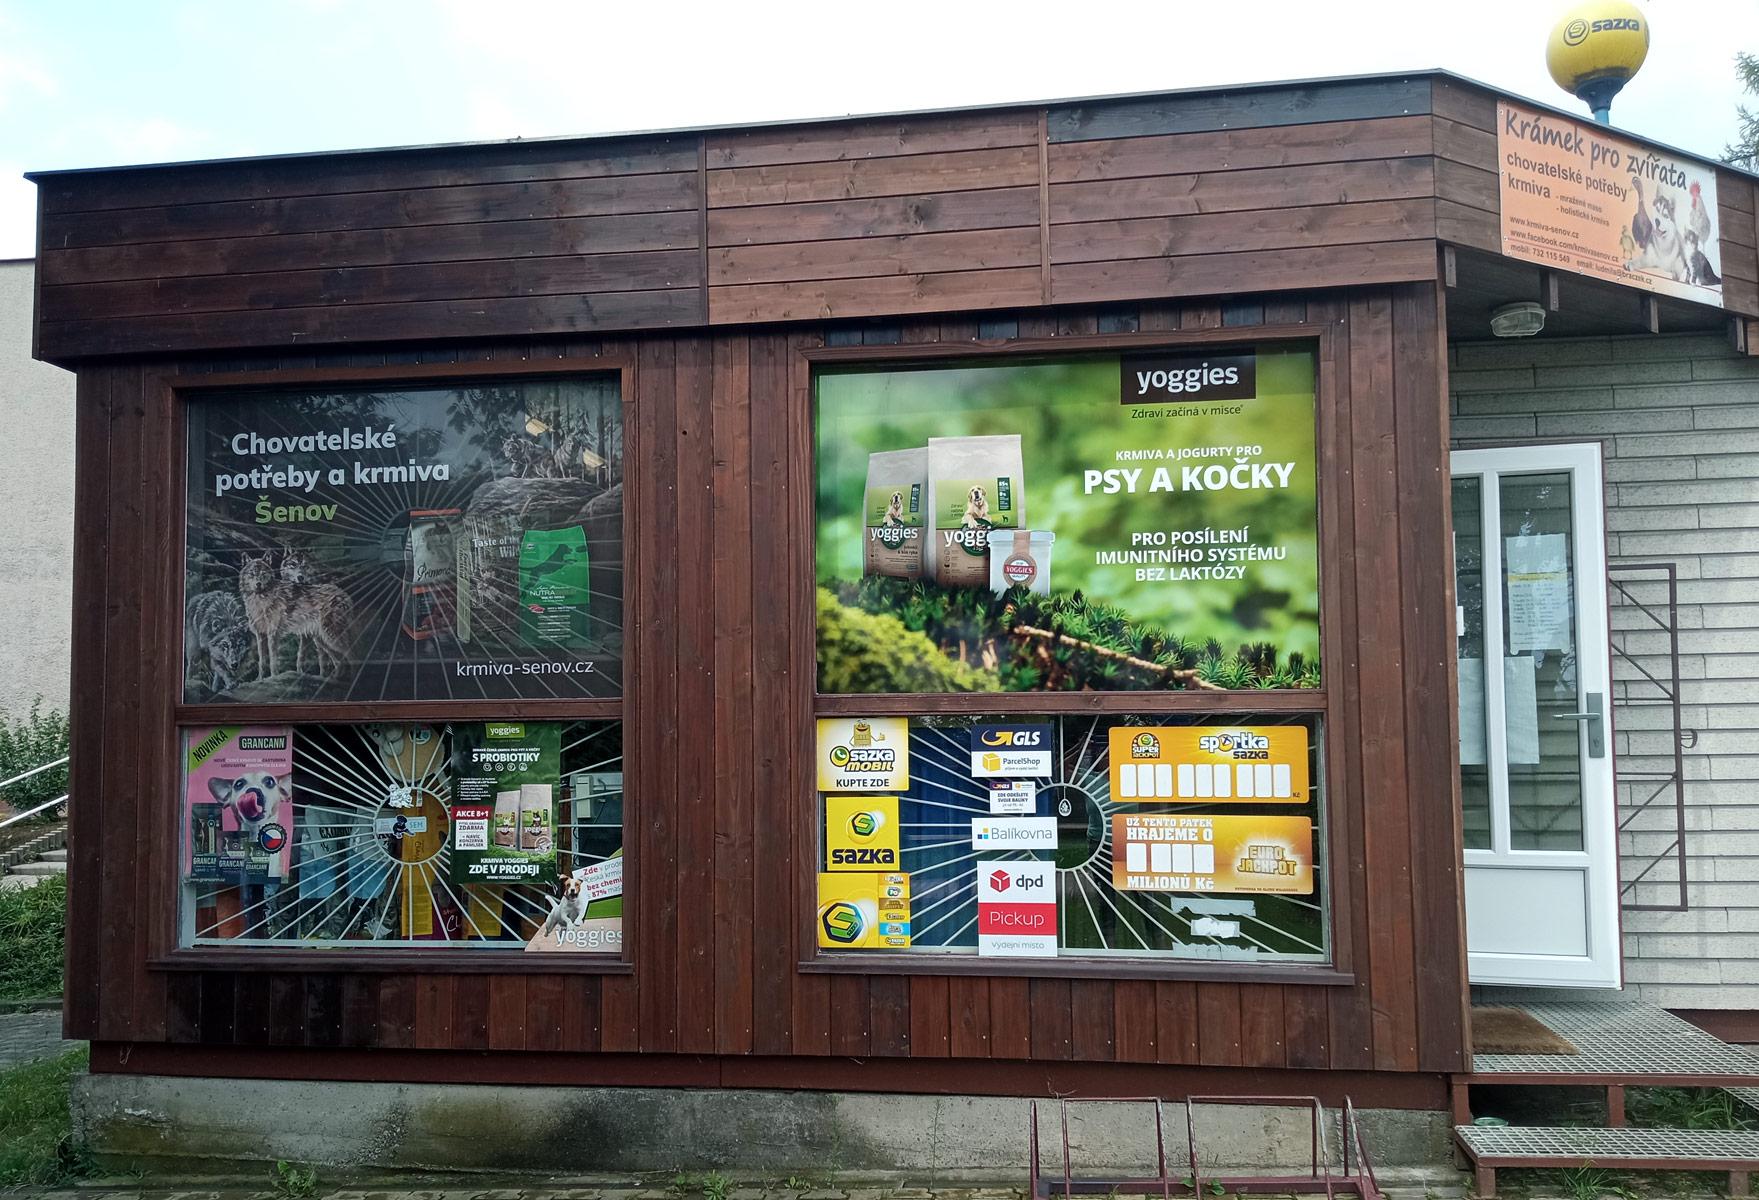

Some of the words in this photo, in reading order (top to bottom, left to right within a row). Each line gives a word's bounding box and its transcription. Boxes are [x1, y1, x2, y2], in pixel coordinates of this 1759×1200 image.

[1505, 109, 1585, 156] Krámek
[1590, 140, 1620, 170] pro
[1626, 152, 1687, 190] zvířata
[1506, 152, 1582, 184] chovatelské
[1585, 175, 1629, 202] potřeby
[1508, 172, 1551, 199] krmiva
[1509, 215, 1580, 239] www.krmiva-senov.cz
[1532, 247, 1544, 258] 732
[1546, 251, 1558, 261] 115
[1137, 362, 1238, 395] yoggies
[1131, 407, 1163, 419] Zdraví
[1166, 406, 1199, 418] začíná
[1202, 408, 1208, 417] v
[232, 424, 397, 456] Chovatelské
[1115, 449, 1164, 461] KRMIVA
[1166, 448, 1175, 459] A
[1177, 446, 1233, 461] JOGURTY
[1236, 445, 1262, 456] PRO
[216, 464, 321, 497] potřeby
[328, 468, 345, 486] a
[354, 458, 450, 485] krmiva
[1084, 468, 1143, 495] PSY
[1149, 467, 1174, 493] A
[1182, 457, 1296, 492] KOČKY
[255, 495, 338, 524] Šenov
[871, 524, 918, 542] yoggies
[944, 525, 991, 547] yogg
[1131, 532, 1166, 546] PRO
[1171, 526, 1249, 545] POSÍLENÍ
[472, 538, 497, 548] Taste
[1096, 546, 1203, 565] IMUNITNÍHO
[1208, 544, 1286, 562] SYSTÉMU
[1135, 567, 1165, 581] BEZ
[1170, 563, 1246, 581] LAKTÓZY
[456, 660, 594, 677] krmiva-senov.cz
[490, 726, 520, 736] yoggies
[1012, 731, 1041, 746] GLS
[193, 728, 229, 762] NOVINKA
[241, 737, 285, 749] GRANCANN
[1199, 732, 1270, 753] sportka
[472, 753, 479, 763] S
[480, 752, 540, 762] PROBIOTIKY
[1003, 757, 1041, 767] ParcelShop
[836, 778, 868, 788] KUPTE
[870, 778, 890, 788] ZDE
[1126, 816, 1140, 827] UŽ
[1143, 817, 1177, 827] TENTO
[991, 827, 1053, 840] Balíkovna
[1126, 827, 1199, 841] HRAJEME
[1202, 828, 1213, 841] O
[468, 864, 489, 874] ZDE
[490, 864, 498, 874] V
[499, 864, 540, 876] PRODEJI
[583, 867, 598, 876] Zde
[587, 882, 599, 891] bez
[1015, 874, 1044, 891] dpd
[1127, 874, 1191, 889] MILIONŮ
[1195, 877, 1214, 890] Kč
[592, 890, 607, 898] 87%
[990, 911, 1045, 928] Pickup
